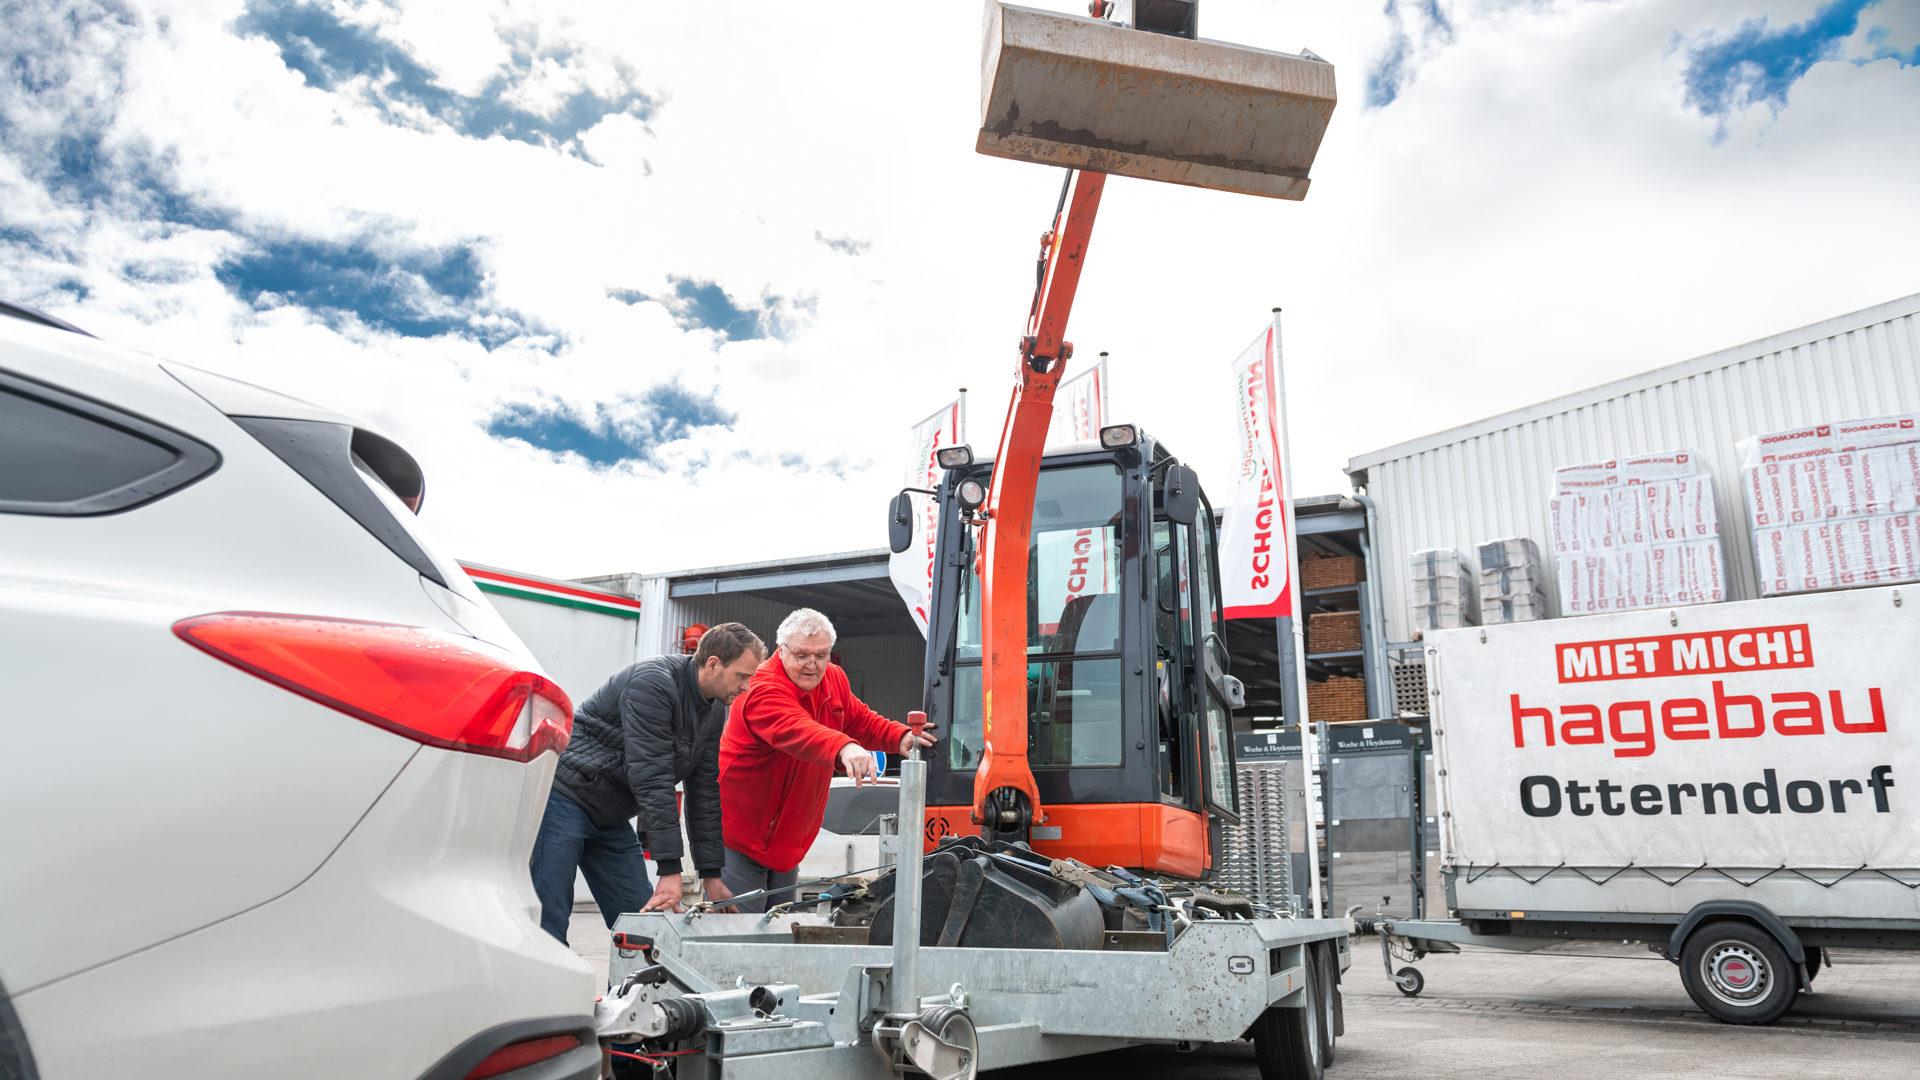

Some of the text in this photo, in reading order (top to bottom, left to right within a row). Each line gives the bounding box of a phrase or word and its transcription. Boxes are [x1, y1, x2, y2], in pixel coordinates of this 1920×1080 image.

[1760, 430, 1814, 444] ROCKWOOL
[1839, 423, 1896, 433] ROCKWOOL
[1751, 467, 1764, 512] ROCKWOOL
[1771, 477, 1784, 522] ROCKWOOL
[1789, 464, 1799, 509] ROCKWOOL
[1808, 474, 1821, 518] ROCKWOOL
[1862, 454, 1874, 500] ROCKWOOL
[1803, 529, 1813, 575] ROCKWOOL
[1885, 517, 1897, 565] ROCKWOOL
[1562, 629, 1806, 678] MIET MICH!
[1510, 680, 1887, 758] hagebau
[1520, 765, 1894, 817] Otterndorf
